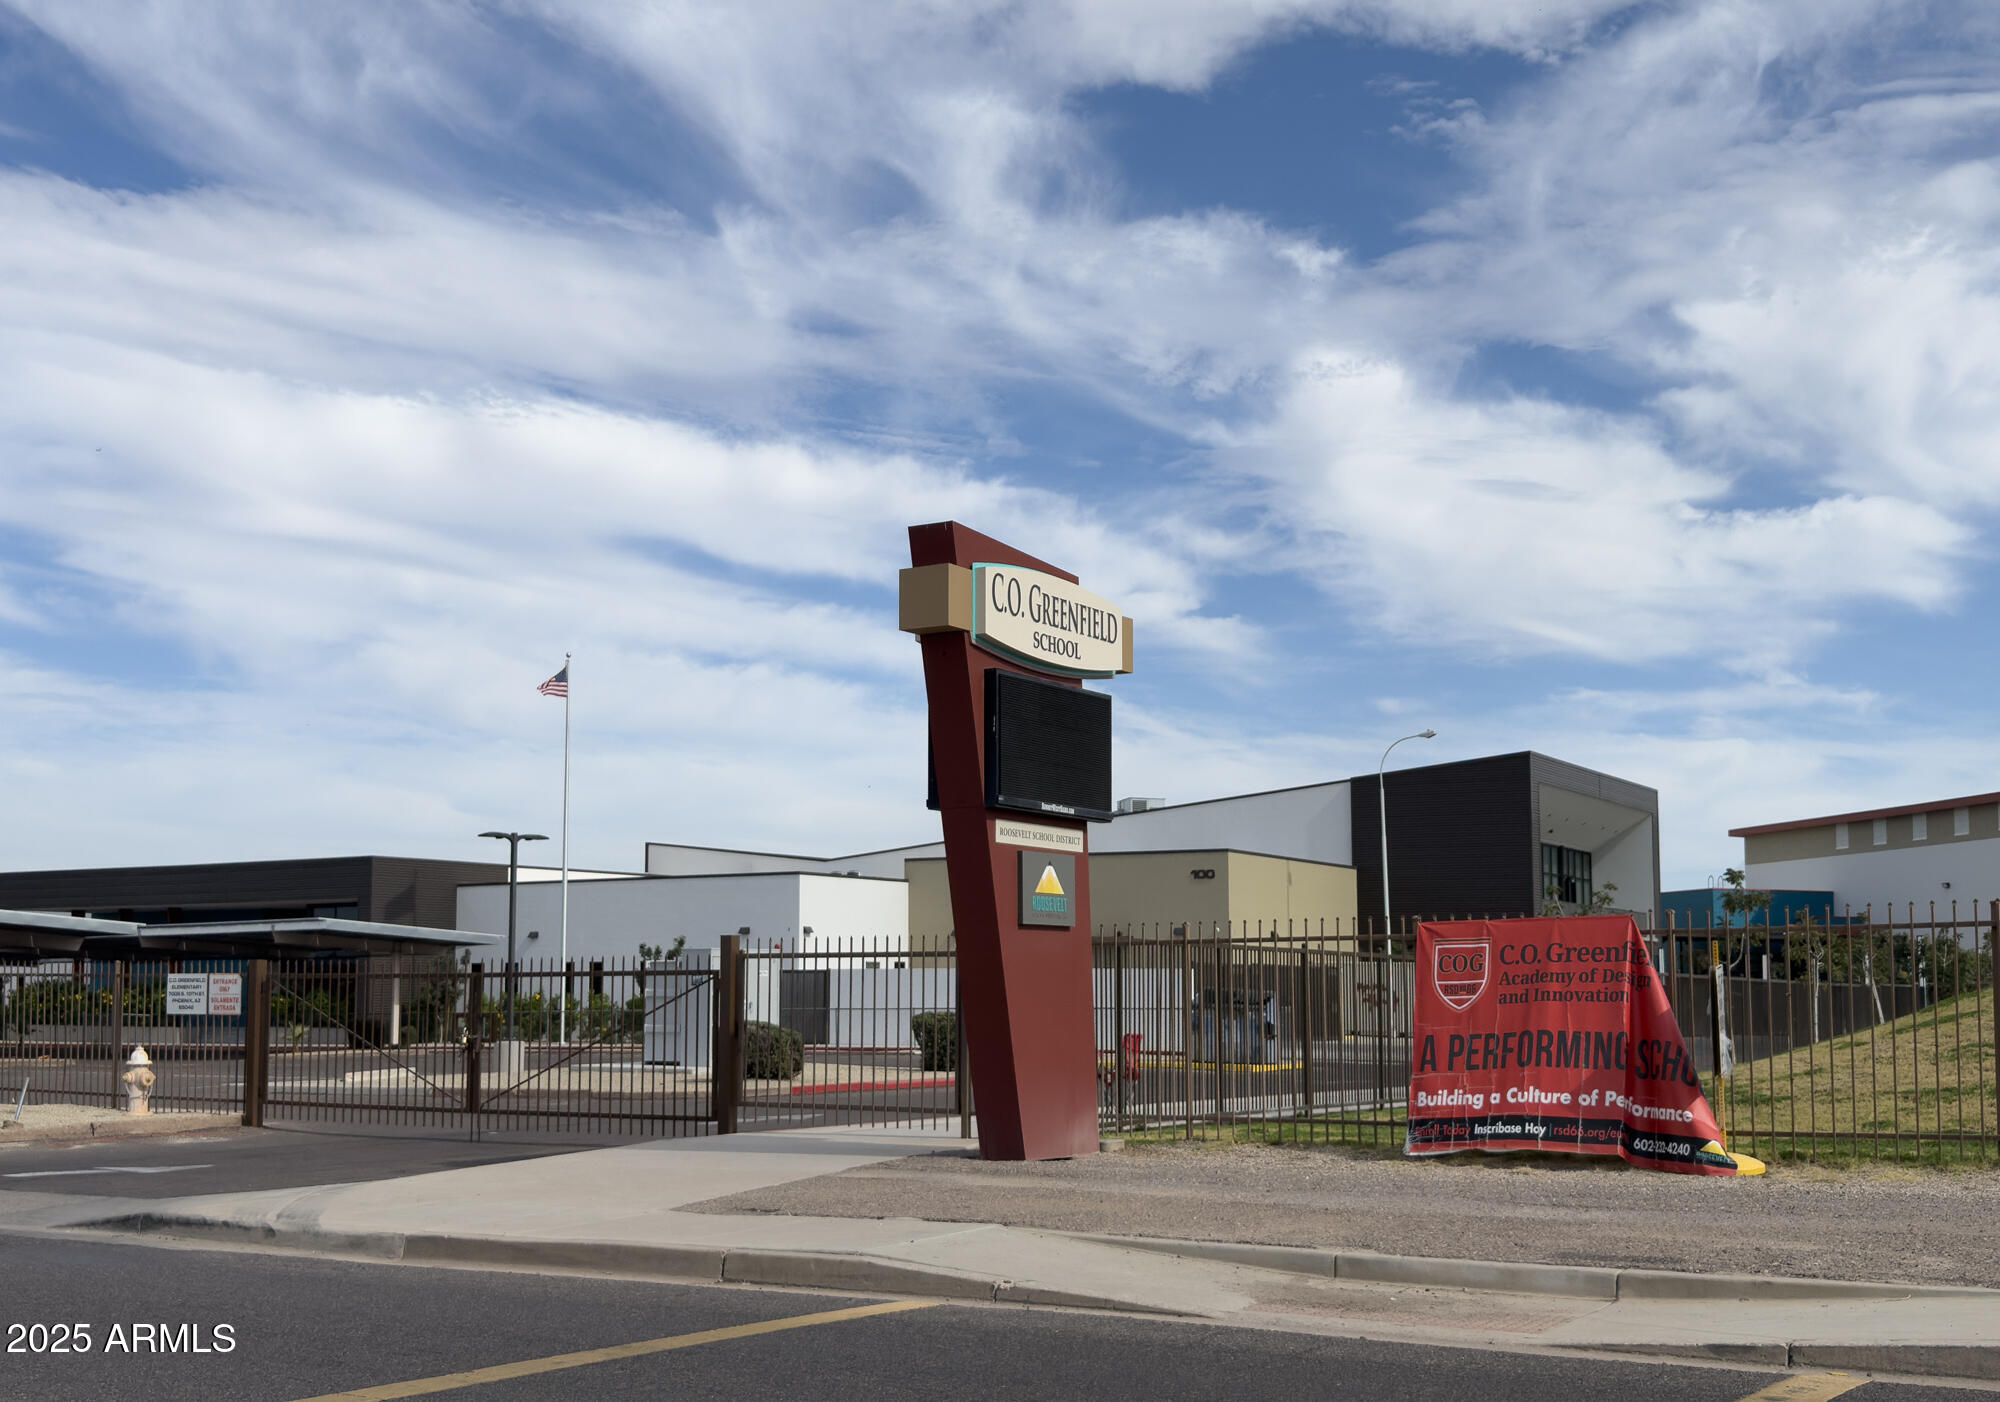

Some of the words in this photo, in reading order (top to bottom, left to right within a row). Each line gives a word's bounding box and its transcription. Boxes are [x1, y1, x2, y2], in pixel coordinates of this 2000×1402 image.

[992, 573, 1025, 618] C.O.
[1029, 584, 1118, 644] GREENFIELD
[1033, 631, 1081, 660] SCHOOL
[1000, 827, 1031, 839] ROOSEVELT
[1032, 831, 1054, 843] SCHOOL
[1056, 834, 1080, 845] DISTRICT
[1191, 869, 1215, 880] 100
[1032, 896, 1068, 912] ROOSEVELT
[1439, 953, 1483, 973] COG
[1500, 944, 1541, 965] C.O.
[1498, 969, 1576, 987] Academy
[1579, 968, 1598, 983] of
[1602, 968, 1651, 992] Design
[1498, 989, 1529, 1004] and
[1534, 987, 1630, 1003] Innovation
[1419, 1034, 1437, 1072] A
[1448, 1029, 1629, 1072] PERFORMING
[1635, 1039, 1699, 1088] SCHO
[1417, 1089, 1484, 1109] Building
[1490, 1092, 1501, 1104] a
[1506, 1086, 1571, 1104] Culture
[1578, 1088, 1599, 1106] of
[1604, 1090, 1693, 1123] Performance
[1415, 1123, 1440, 1137] Enroll
[1443, 1123, 1471, 1138] Today
[1525, 1122, 1546, 1137] Hoy
